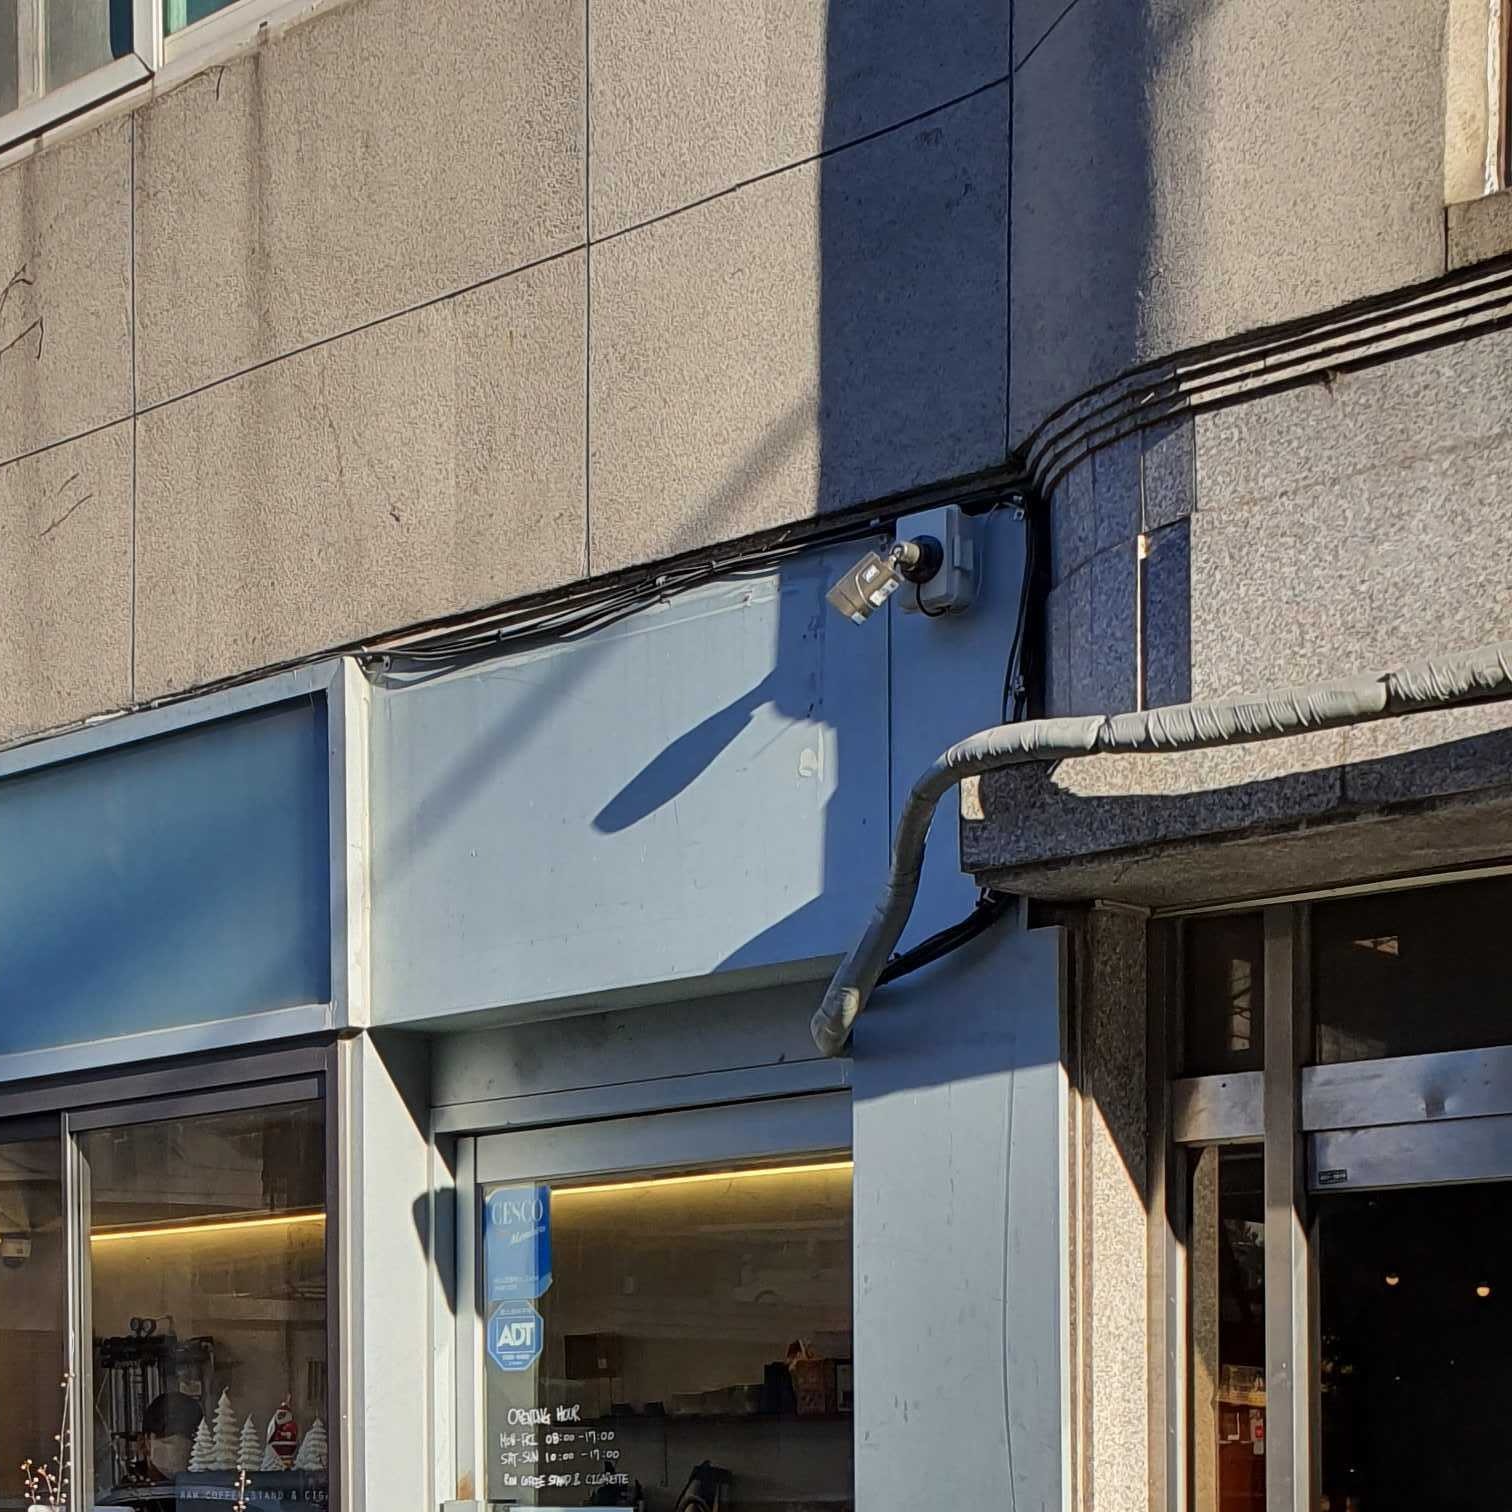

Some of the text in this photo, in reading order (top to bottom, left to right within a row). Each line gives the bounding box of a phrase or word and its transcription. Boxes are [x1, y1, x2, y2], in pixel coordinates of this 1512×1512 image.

[491, 1200, 543, 1225] CESCO
[497, 1323, 535, 1346] ADT
[556, 1404, 581, 1422] HOUR
